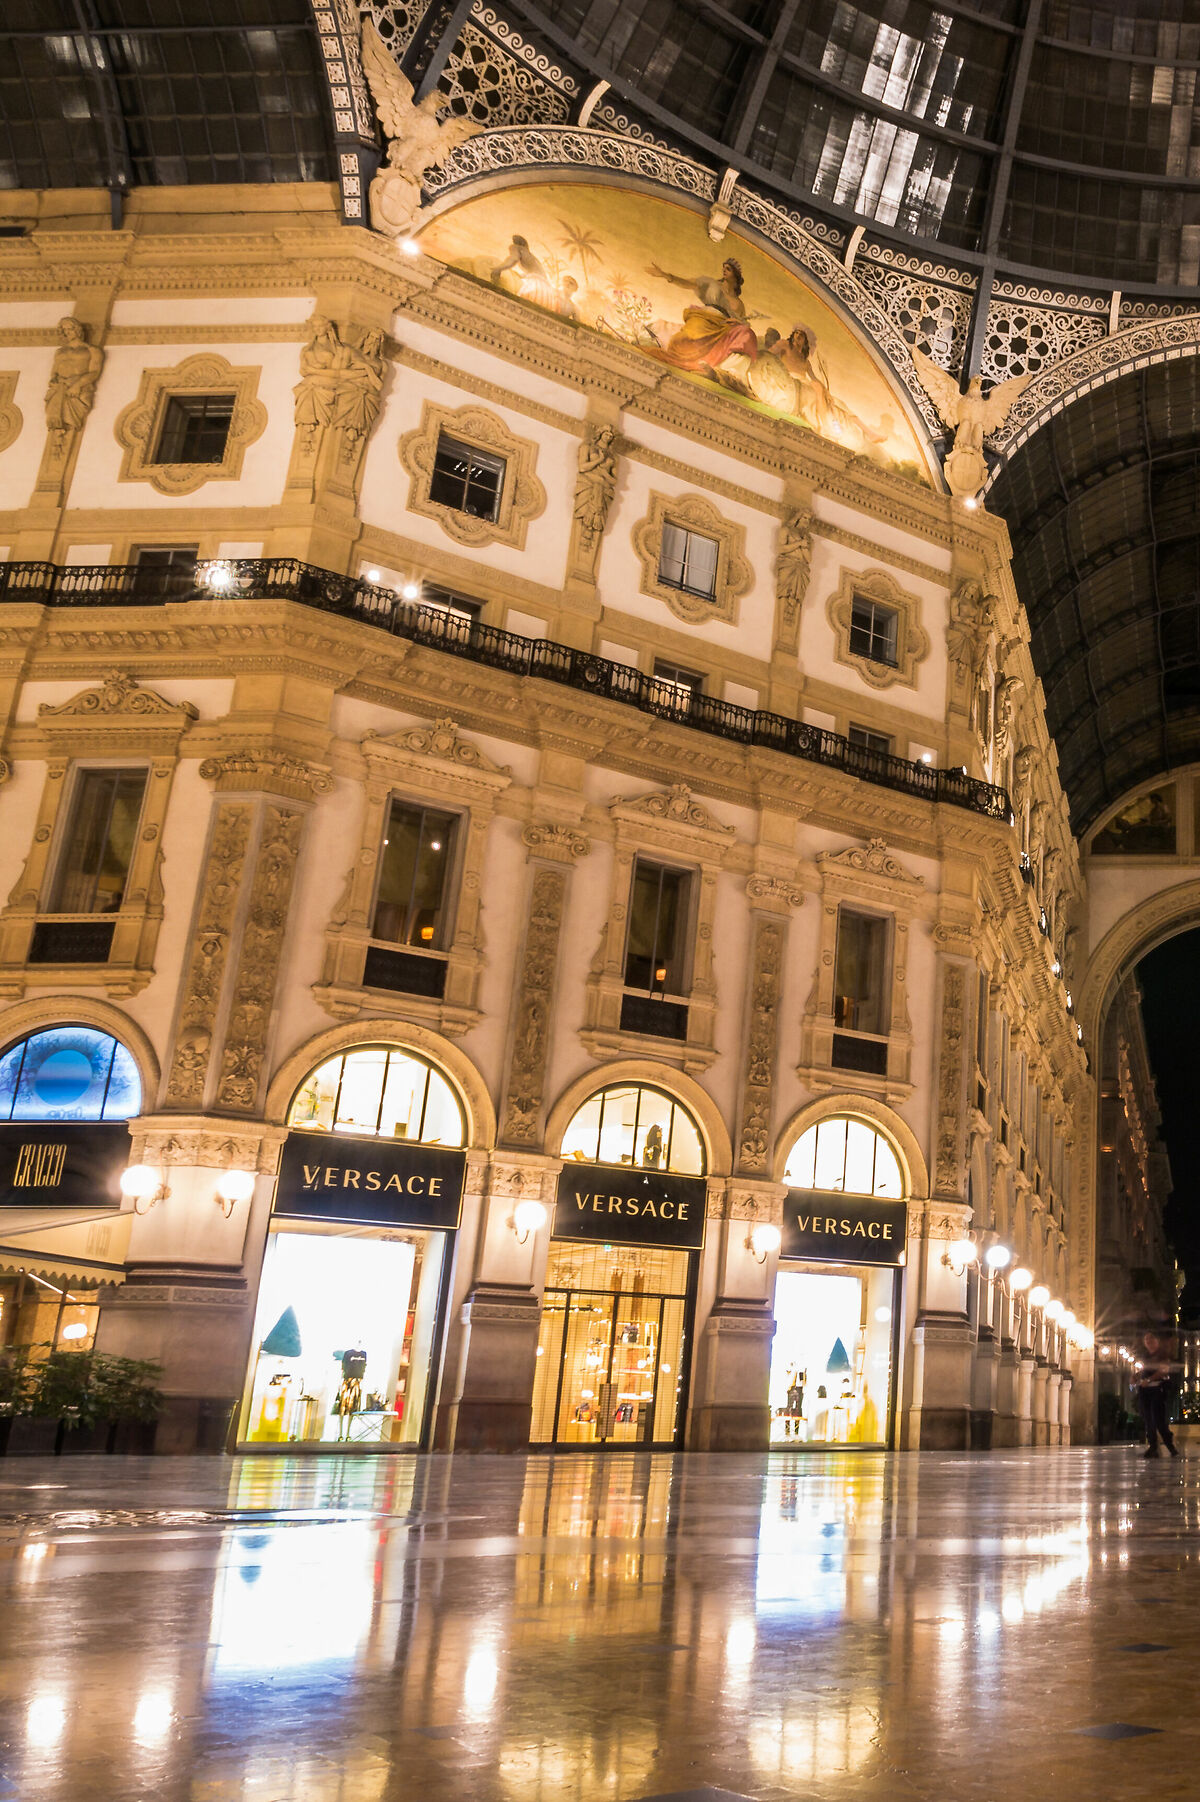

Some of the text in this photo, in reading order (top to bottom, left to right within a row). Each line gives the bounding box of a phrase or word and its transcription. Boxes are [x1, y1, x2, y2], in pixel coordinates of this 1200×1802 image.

[13, 1143, 67, 1188] CRACCO
[303, 1164, 443, 1197] VERSACE
[575, 1191, 689, 1221] VERSACE
[797, 1215, 893, 1241] VERSACE
